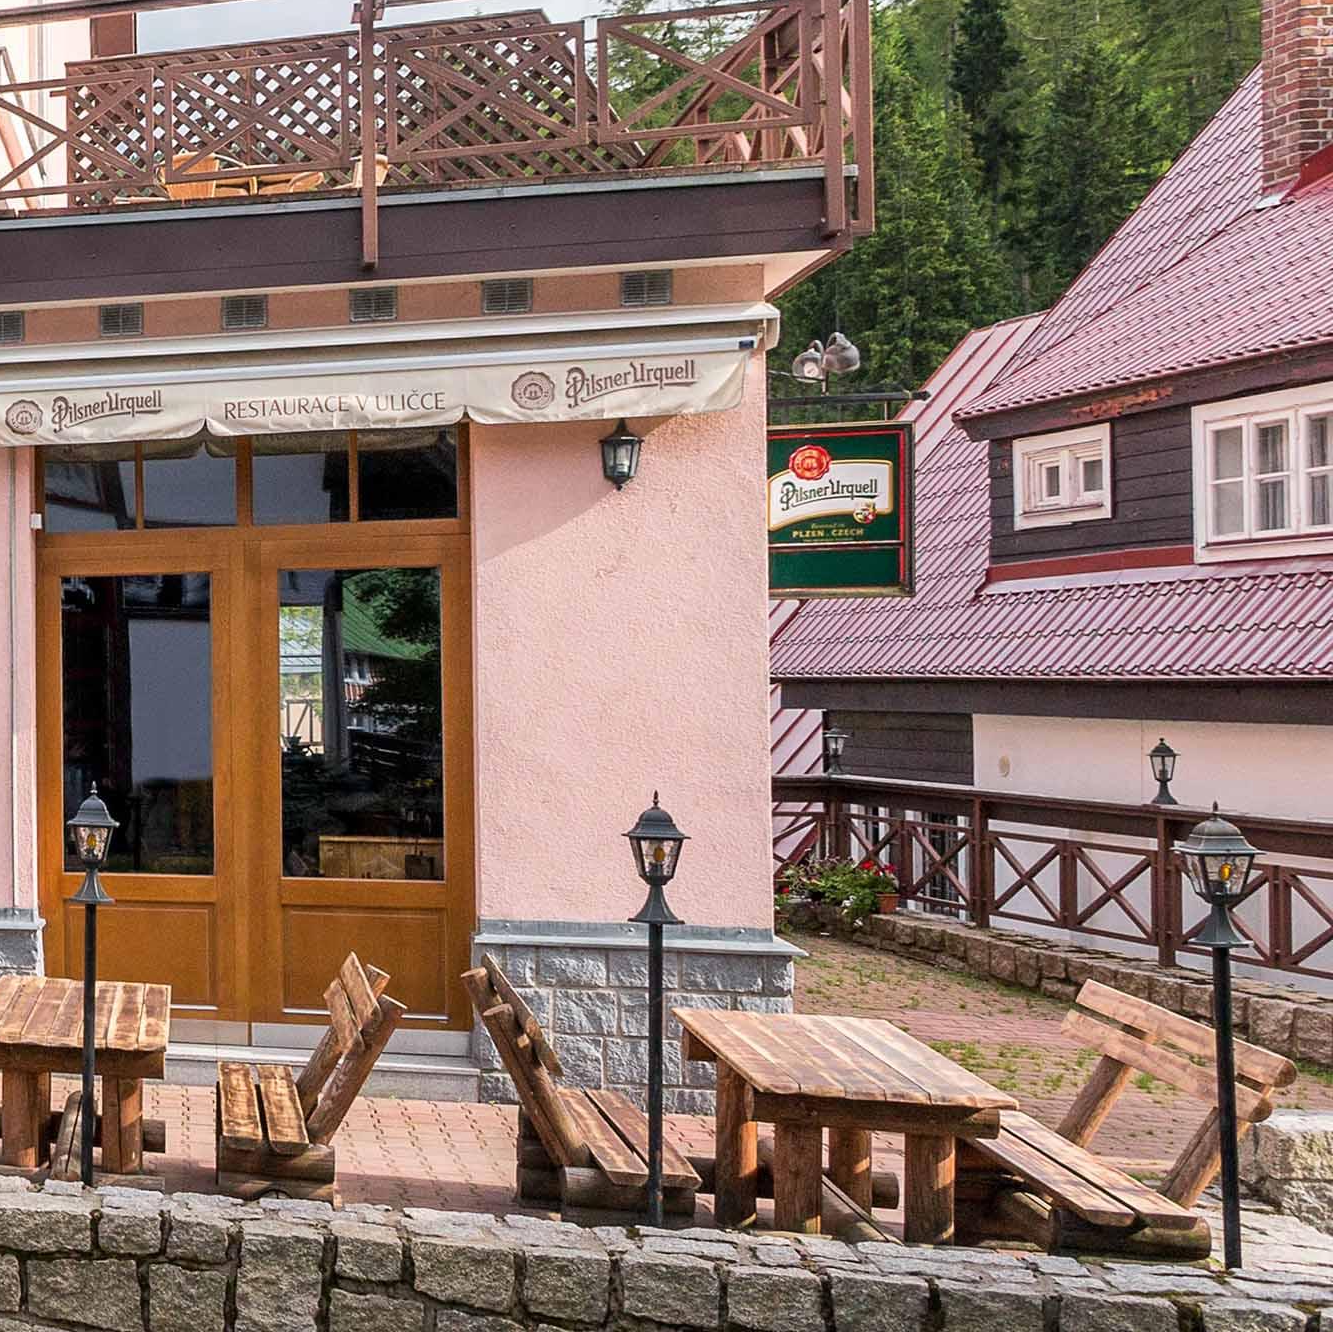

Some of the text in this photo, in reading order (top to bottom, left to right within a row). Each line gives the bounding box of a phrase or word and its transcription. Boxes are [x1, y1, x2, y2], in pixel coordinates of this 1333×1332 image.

[565, 359, 695, 409] Pilsner Urquell
[51, 389, 163, 433] Pilsner Urquell
[224, 389, 446, 420] RESTAURACE V ULIČCE
[780, 478, 878, 511] Pilsner Urquell
